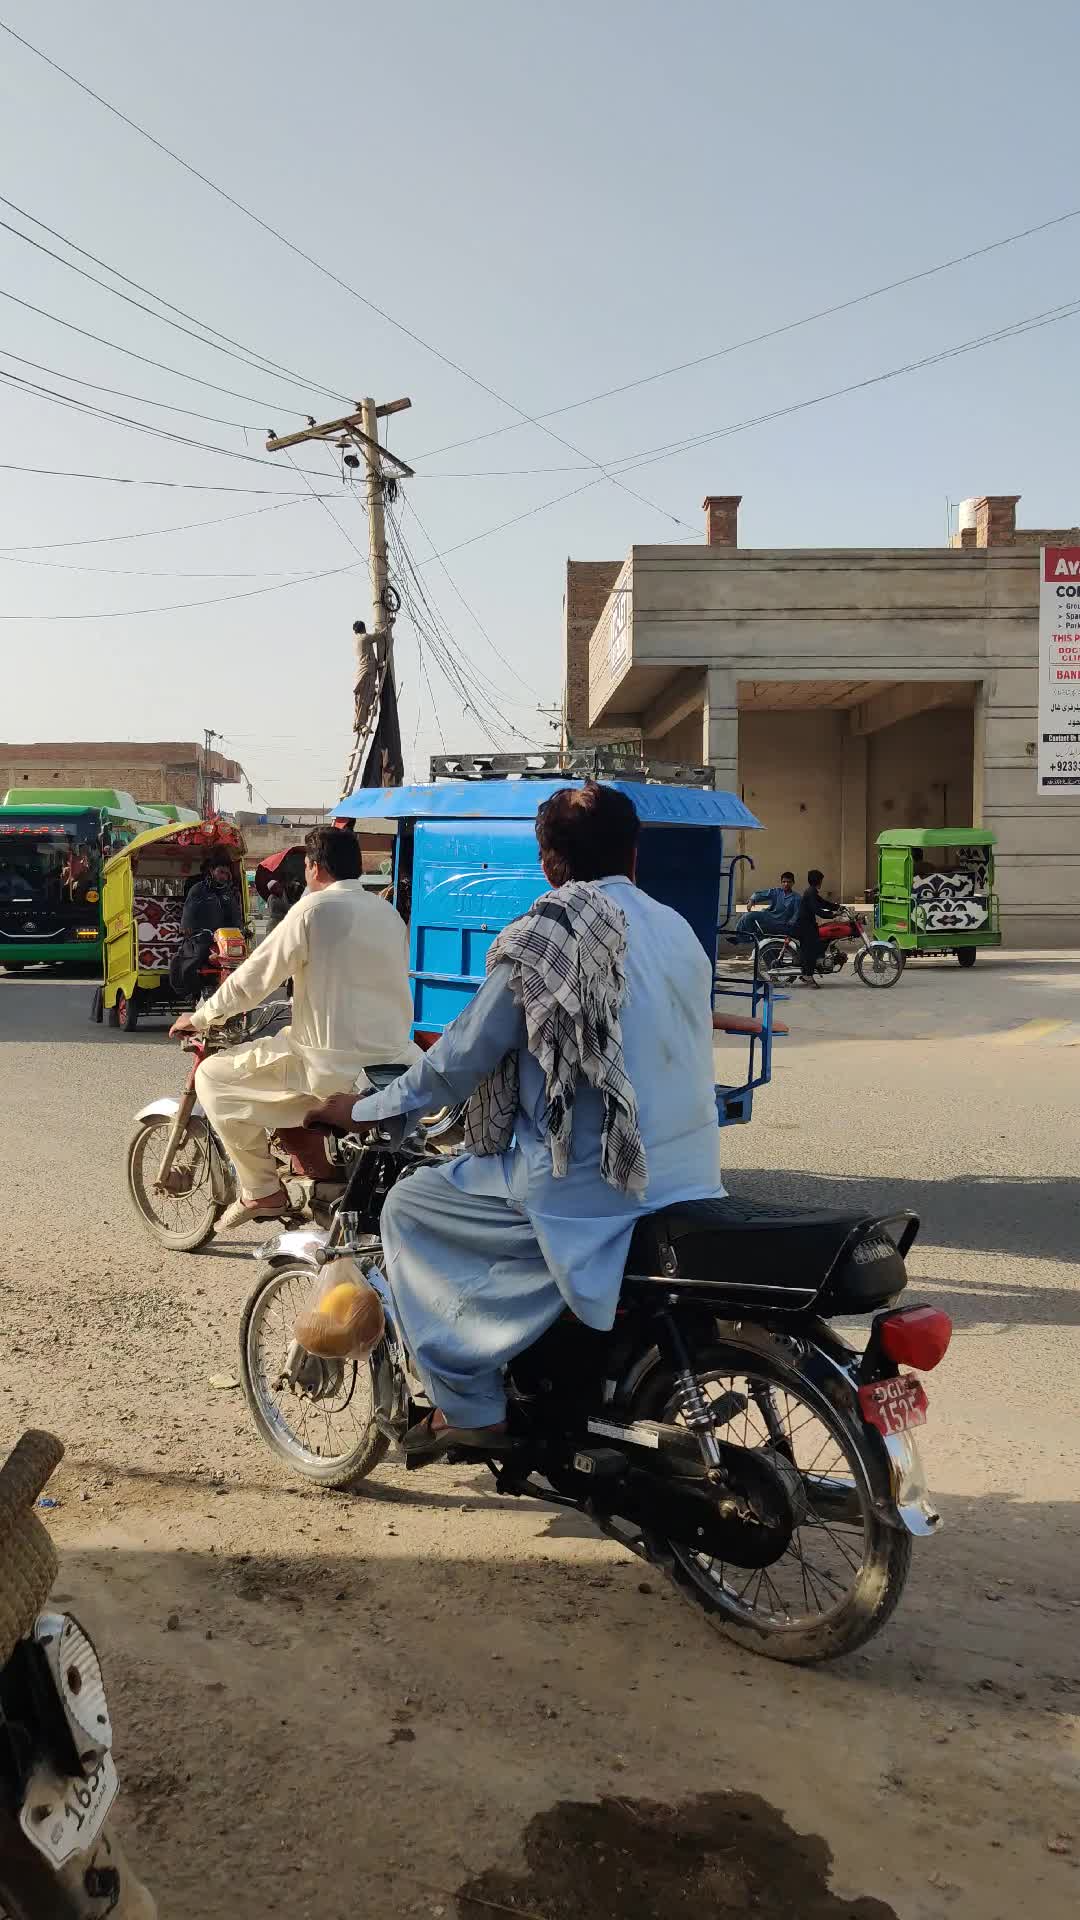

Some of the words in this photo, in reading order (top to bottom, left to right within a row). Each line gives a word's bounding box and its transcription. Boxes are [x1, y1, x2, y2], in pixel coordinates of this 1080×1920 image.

[1054, 558, 1080, 575] Av
[1066, 612, 1080, 620] Spa
[1052, 634, 1072, 642] THIS
